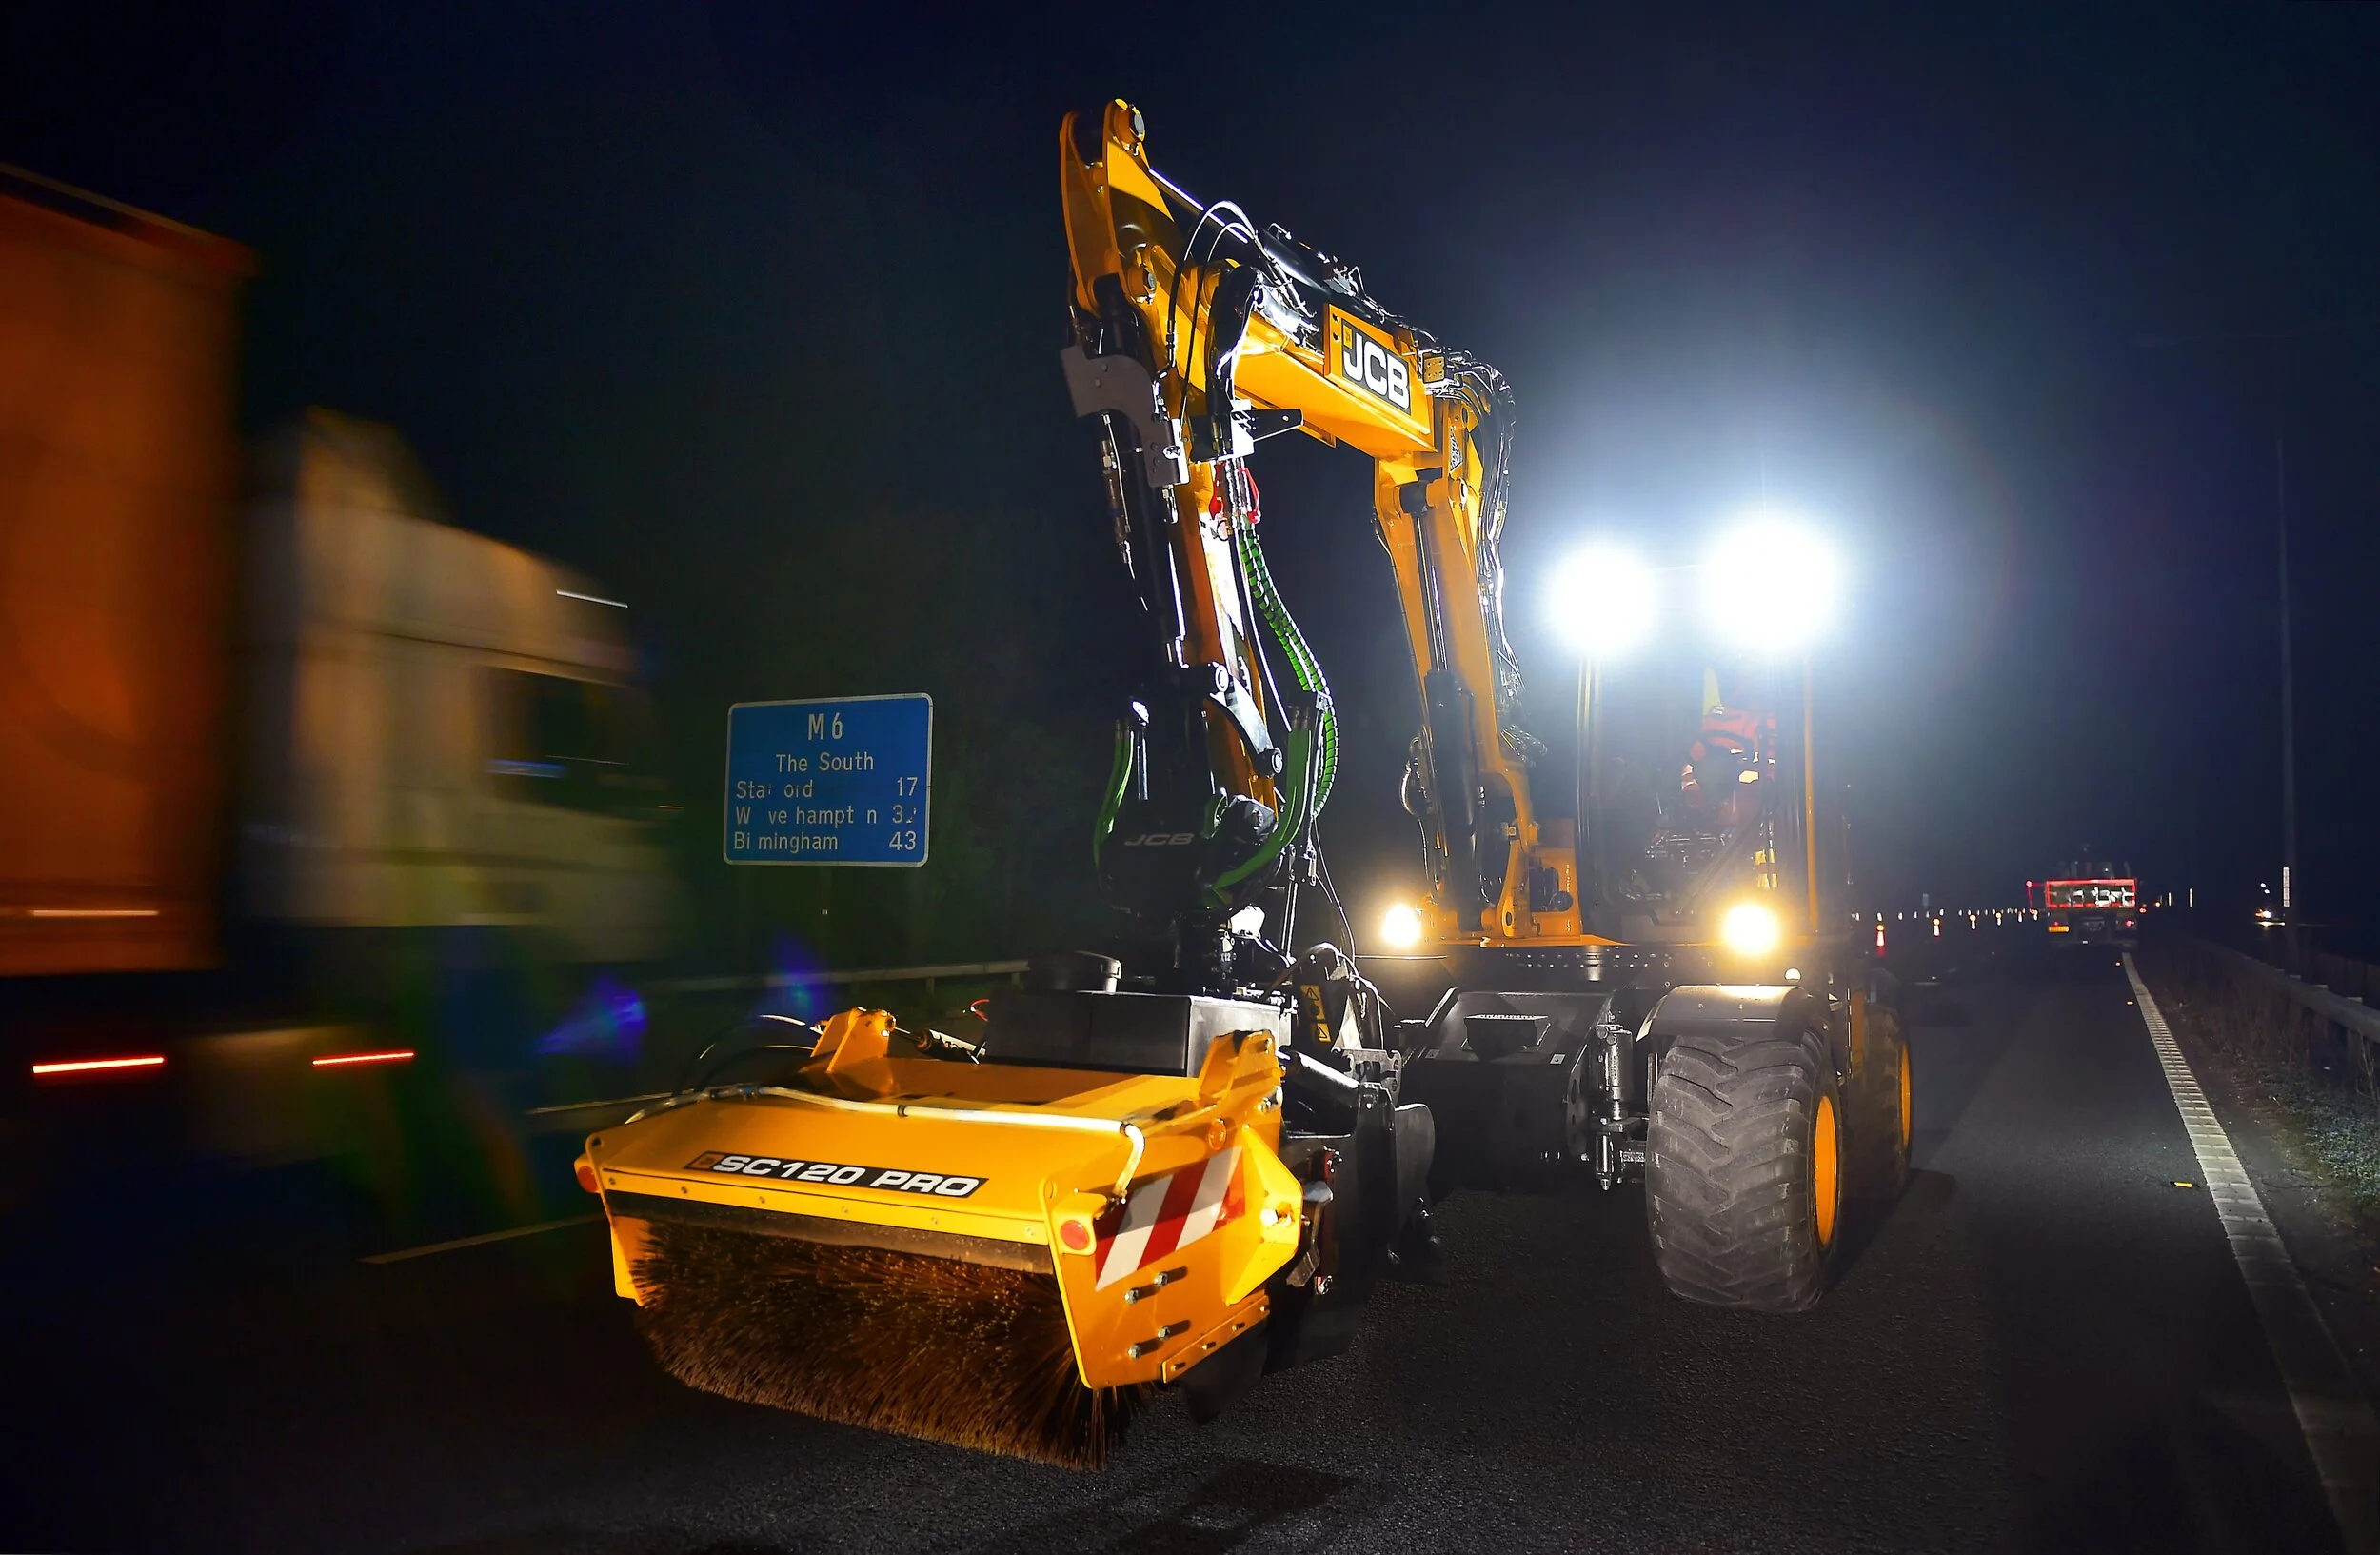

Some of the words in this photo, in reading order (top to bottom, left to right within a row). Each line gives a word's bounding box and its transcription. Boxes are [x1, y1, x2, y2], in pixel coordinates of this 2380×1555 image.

[1343, 333, 1410, 409] JCB
[776, 754, 808, 772] The
[818, 751, 874, 771] South
[897, 776, 918, 796] 17
[736, 806, 877, 828] Wvehamptn
[734, 831, 838, 853] Bimingham
[888, 830, 917, 850] 43
[1124, 833, 1195, 846] JCB
[713, 1155, 866, 1185] SC120
[869, 1170, 980, 1197] PRO
